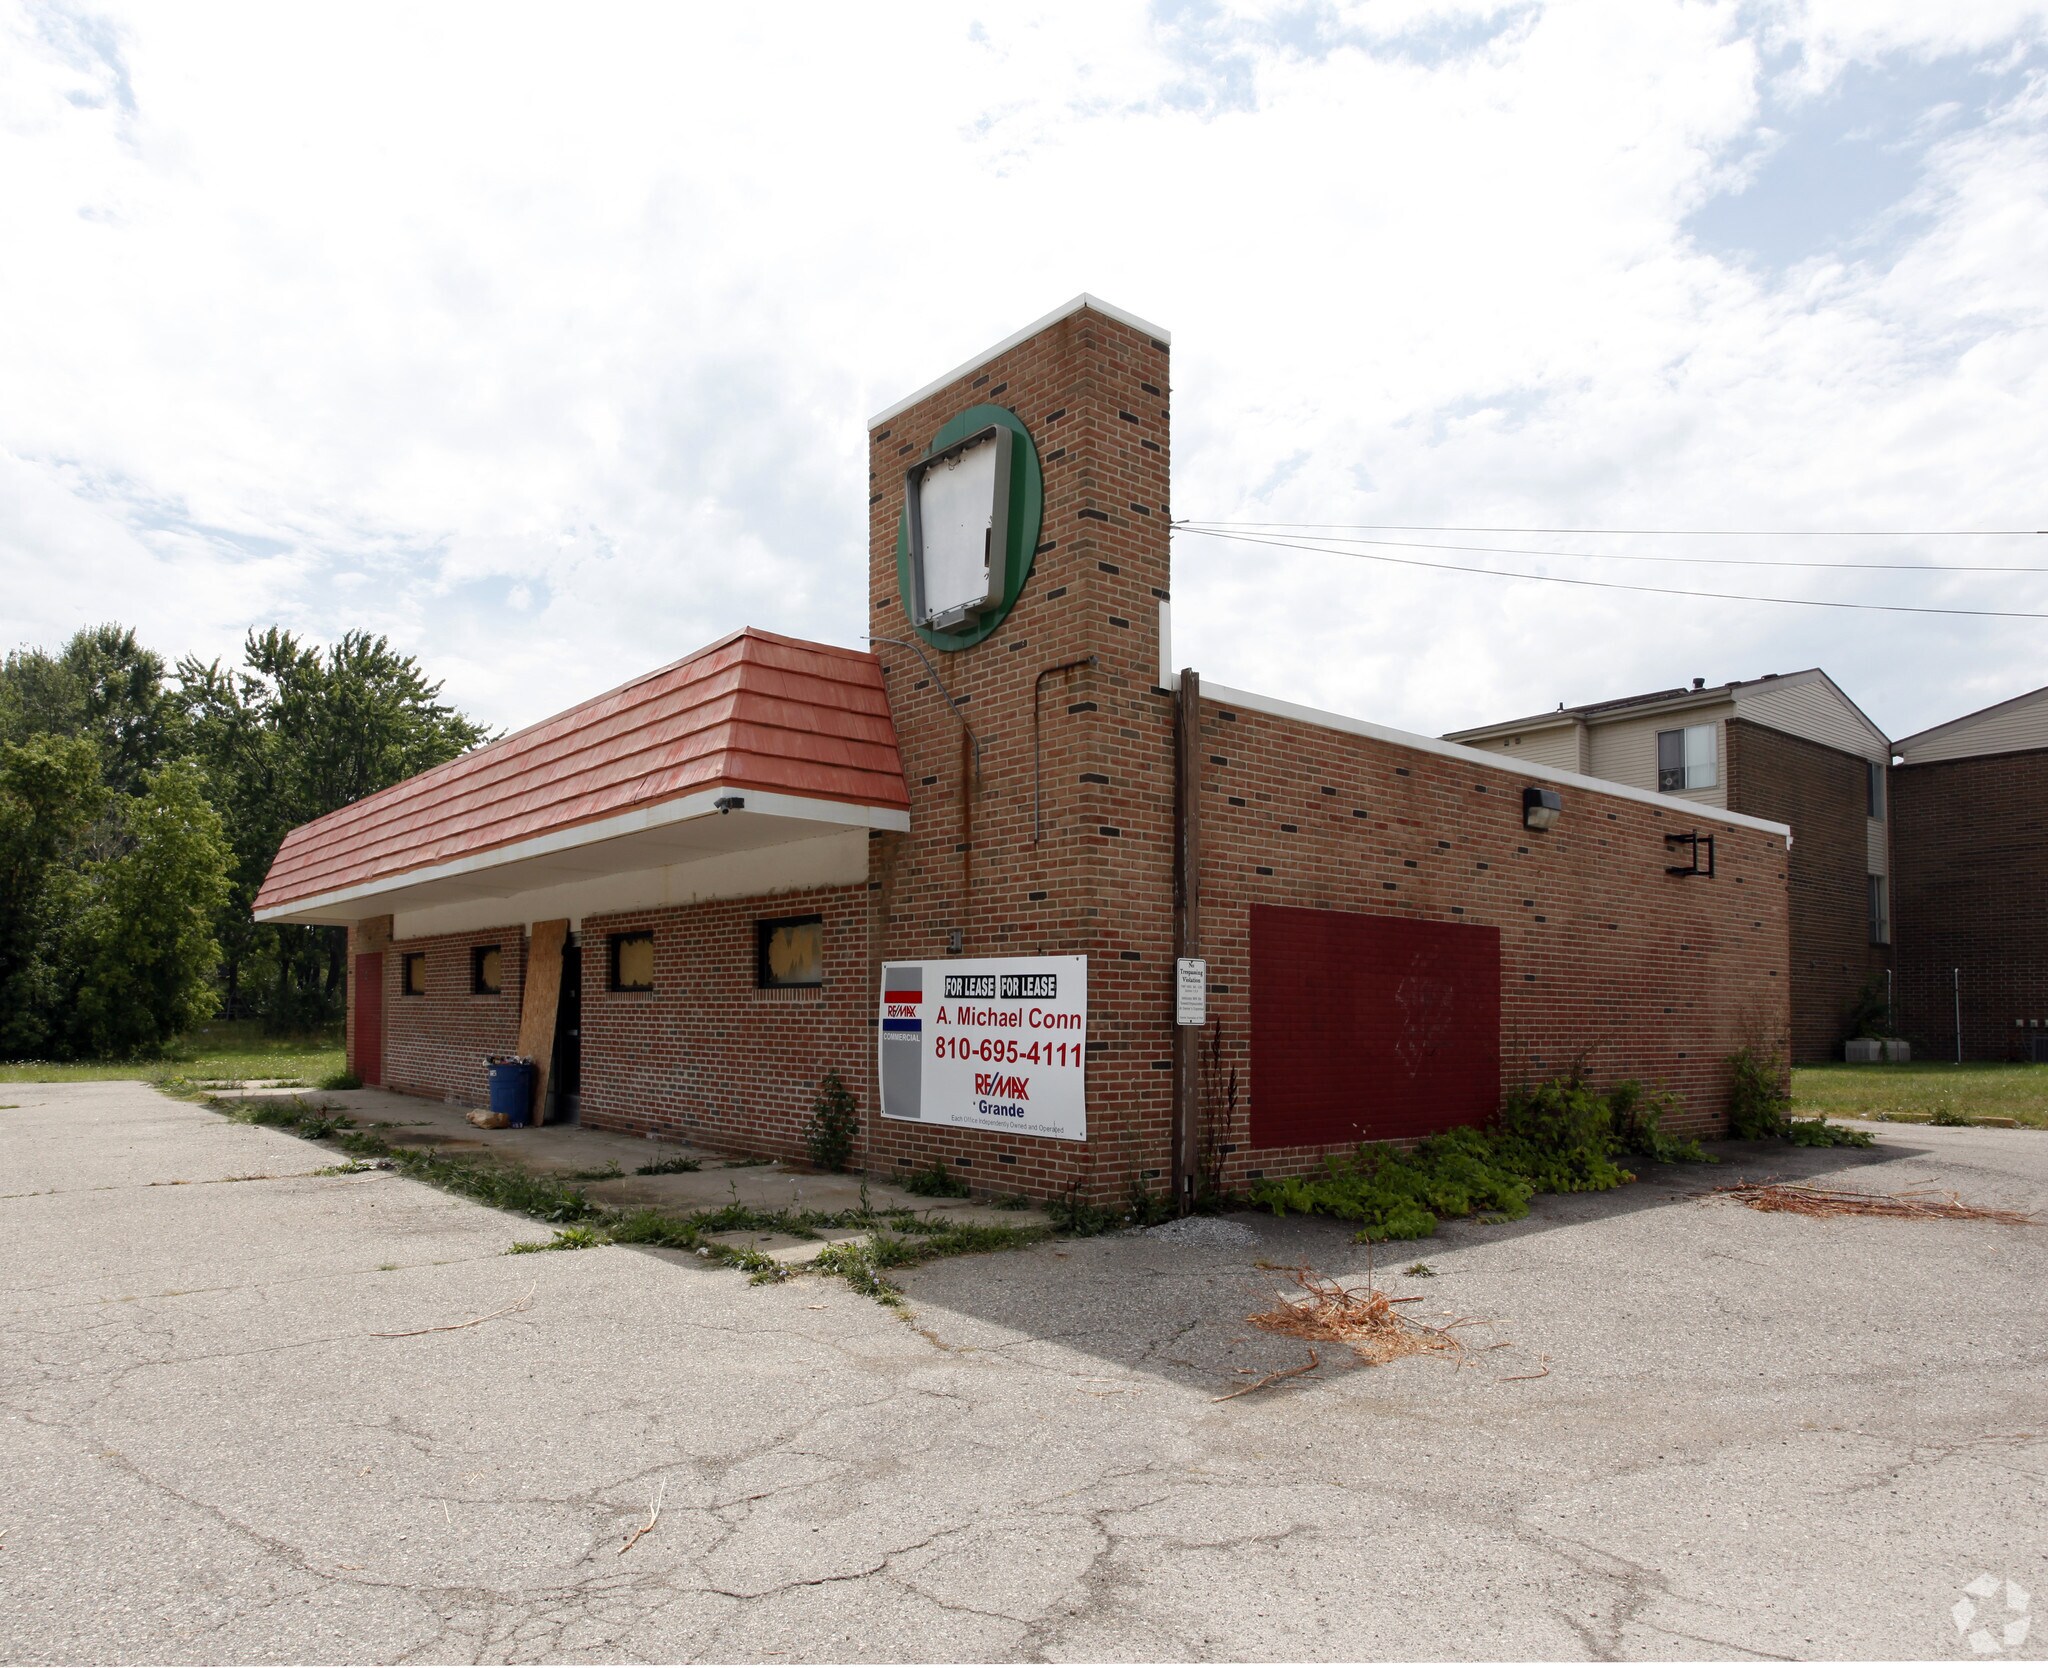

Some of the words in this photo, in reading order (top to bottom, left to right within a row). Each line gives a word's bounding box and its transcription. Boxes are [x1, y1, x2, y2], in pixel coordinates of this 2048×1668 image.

[946, 978, 962, 996] FOR
[965, 977, 994, 996] LEASE
[1001, 977, 1019, 996] FOR
[1022, 976, 1055, 996] LEASE
[888, 1005, 916, 1017] RE/MAX
[936, 1006, 952, 1025] A.
[958, 1007, 1022, 1027] Michael
[1029, 1008, 1081, 1029] Conn
[884, 1032, 920, 1041] COMMERCIAL
[935, 1036, 1081, 1067] 810-695-4111
[975, 1072, 1030, 1100] RE/MAX
[979, 1100, 1024, 1118] Grande
[979, 1118, 1009, 1128] Independently
[1039, 1125, 1064, 1133] Operated
